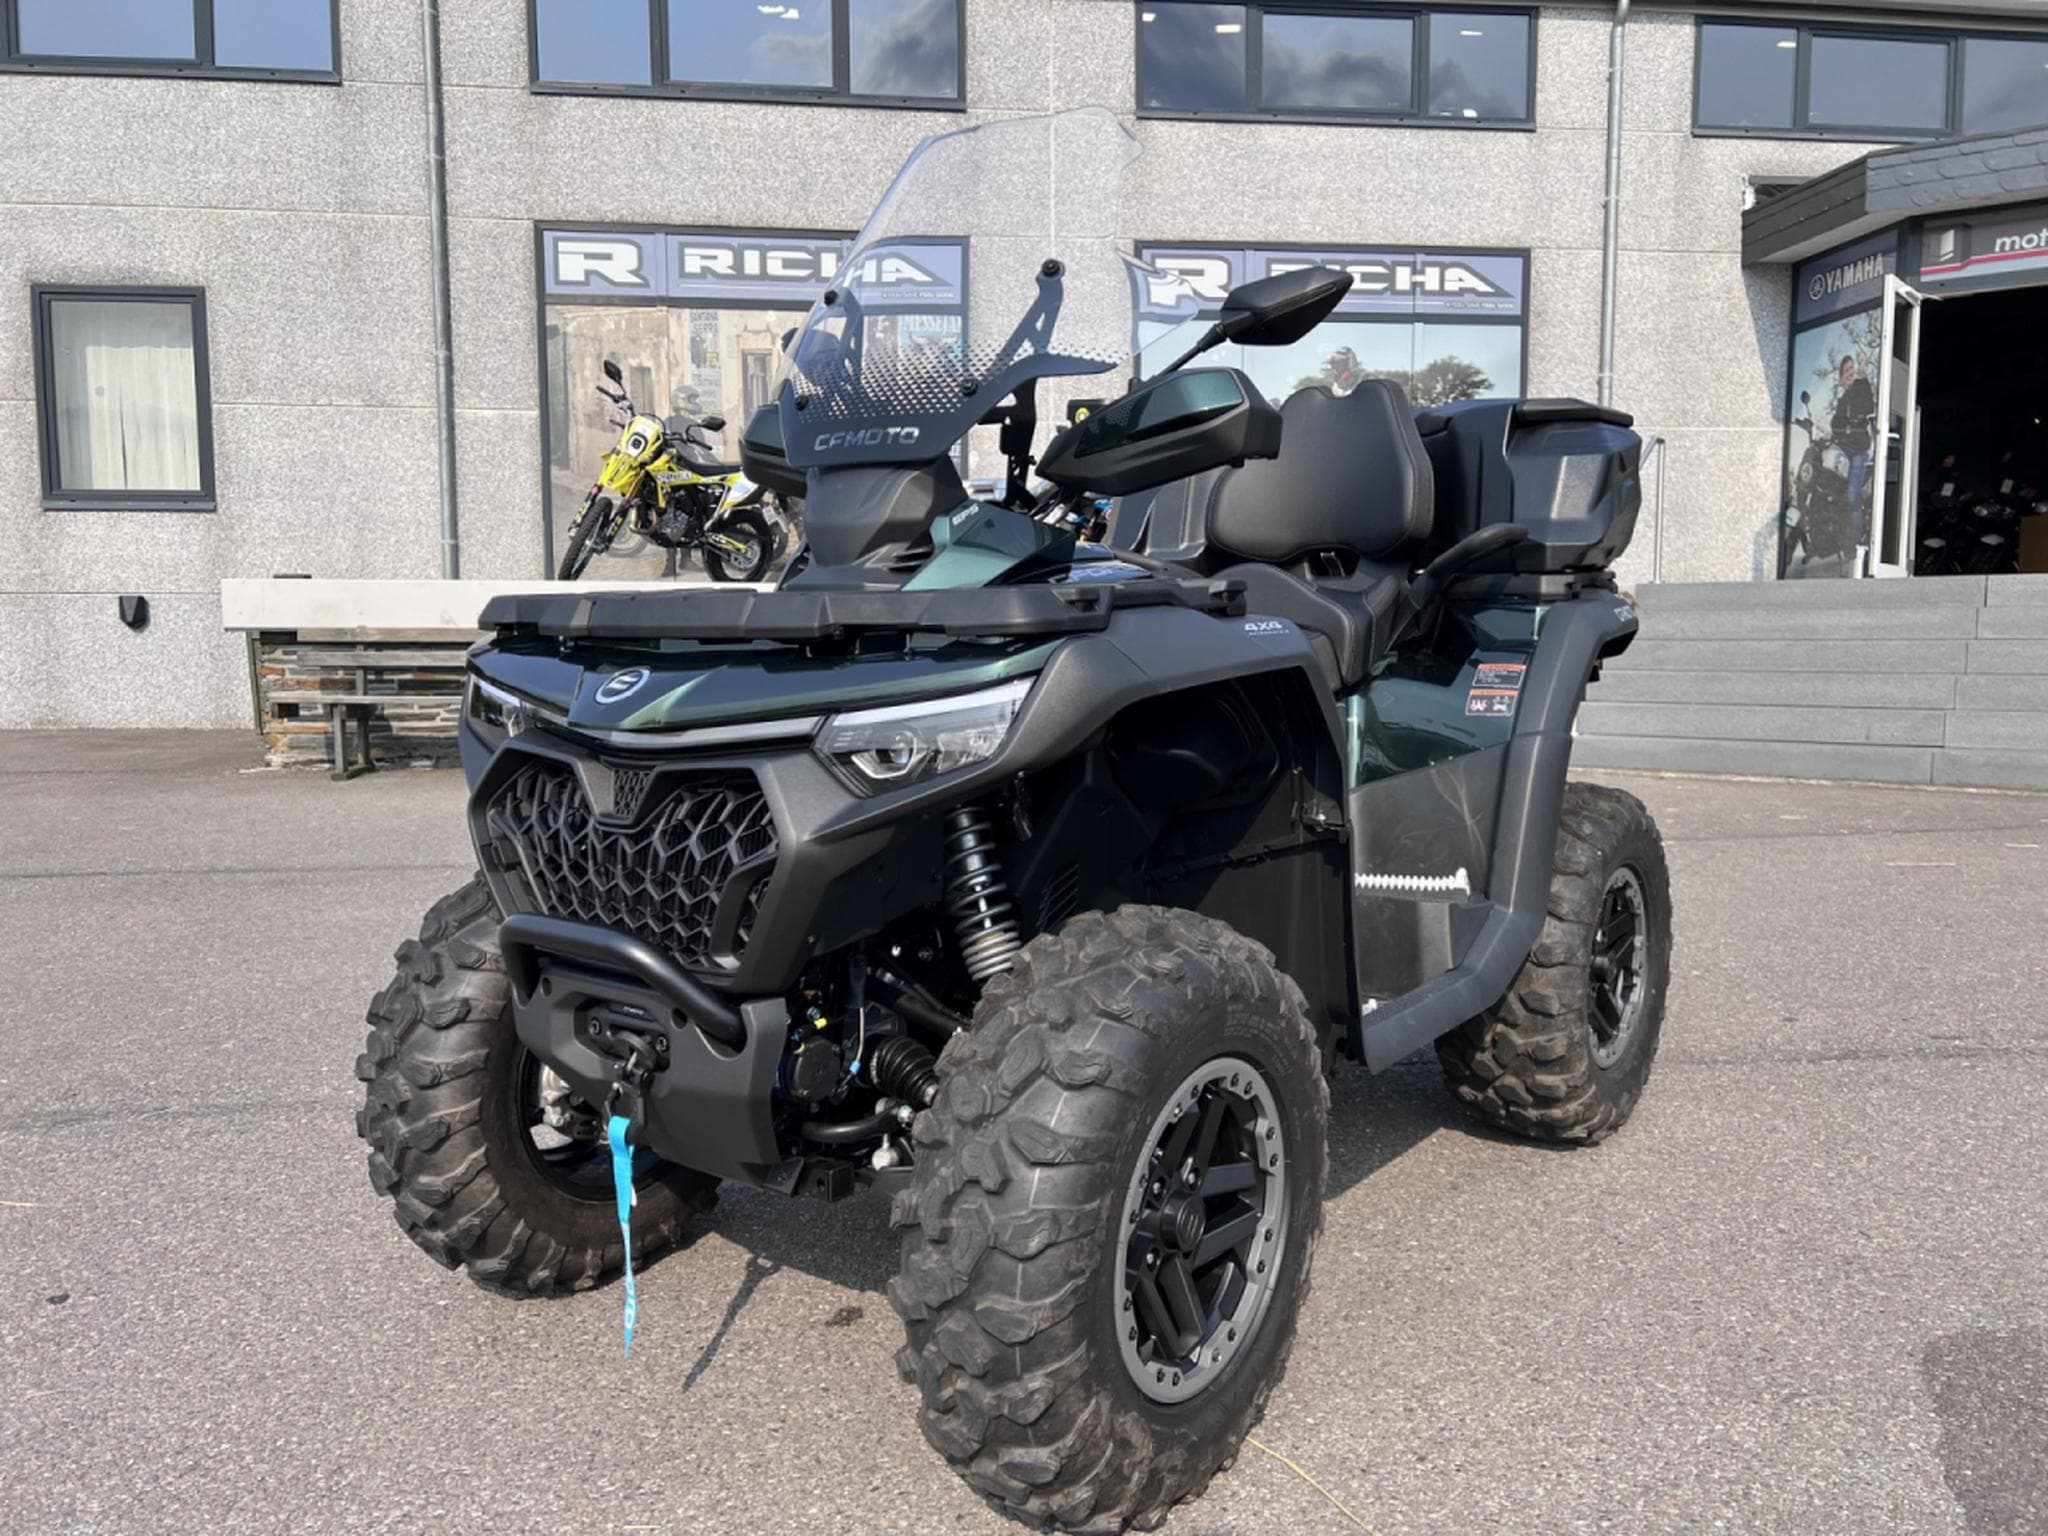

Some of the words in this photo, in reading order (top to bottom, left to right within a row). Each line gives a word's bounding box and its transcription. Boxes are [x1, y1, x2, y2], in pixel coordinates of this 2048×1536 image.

[680, 244, 945, 286] RICHA
[1825, 253, 1884, 294] YAMAHA
[814, 427, 919, 451] CFMOTO
